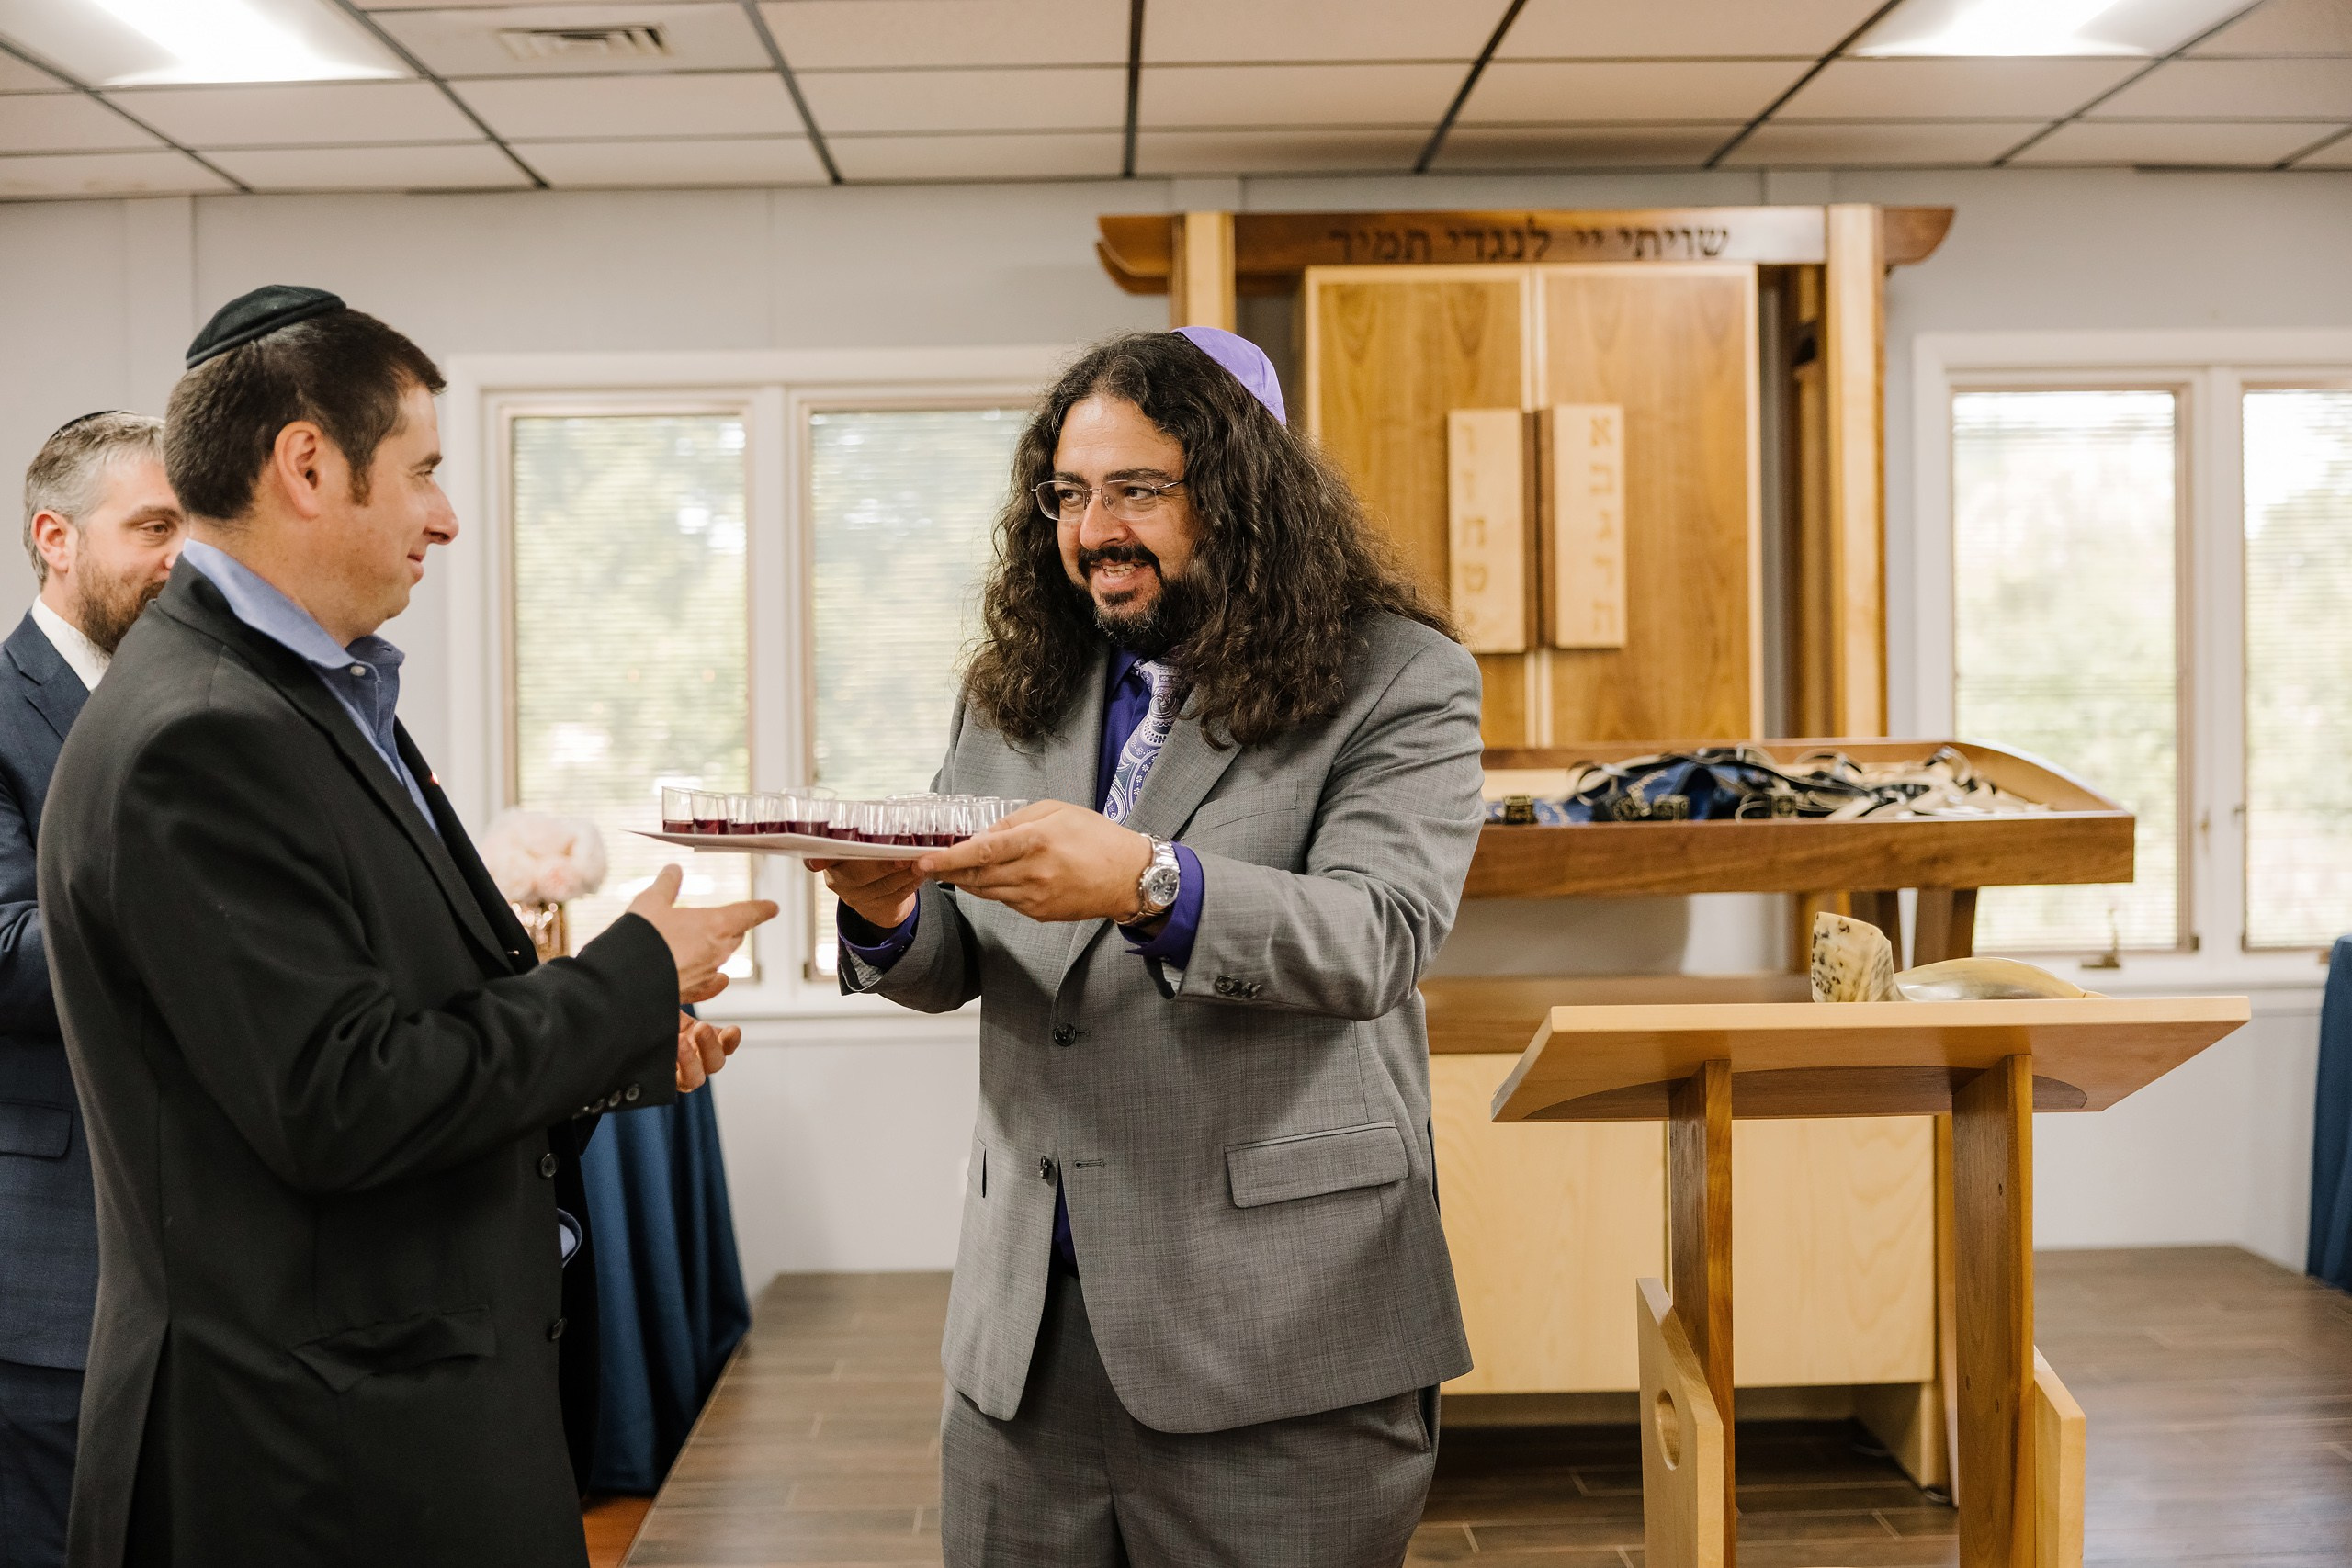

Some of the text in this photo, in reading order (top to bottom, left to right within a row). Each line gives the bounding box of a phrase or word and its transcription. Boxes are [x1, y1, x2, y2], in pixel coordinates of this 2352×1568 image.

[1329, 214, 1729, 263] שויתי יי לנגדי תמיד
